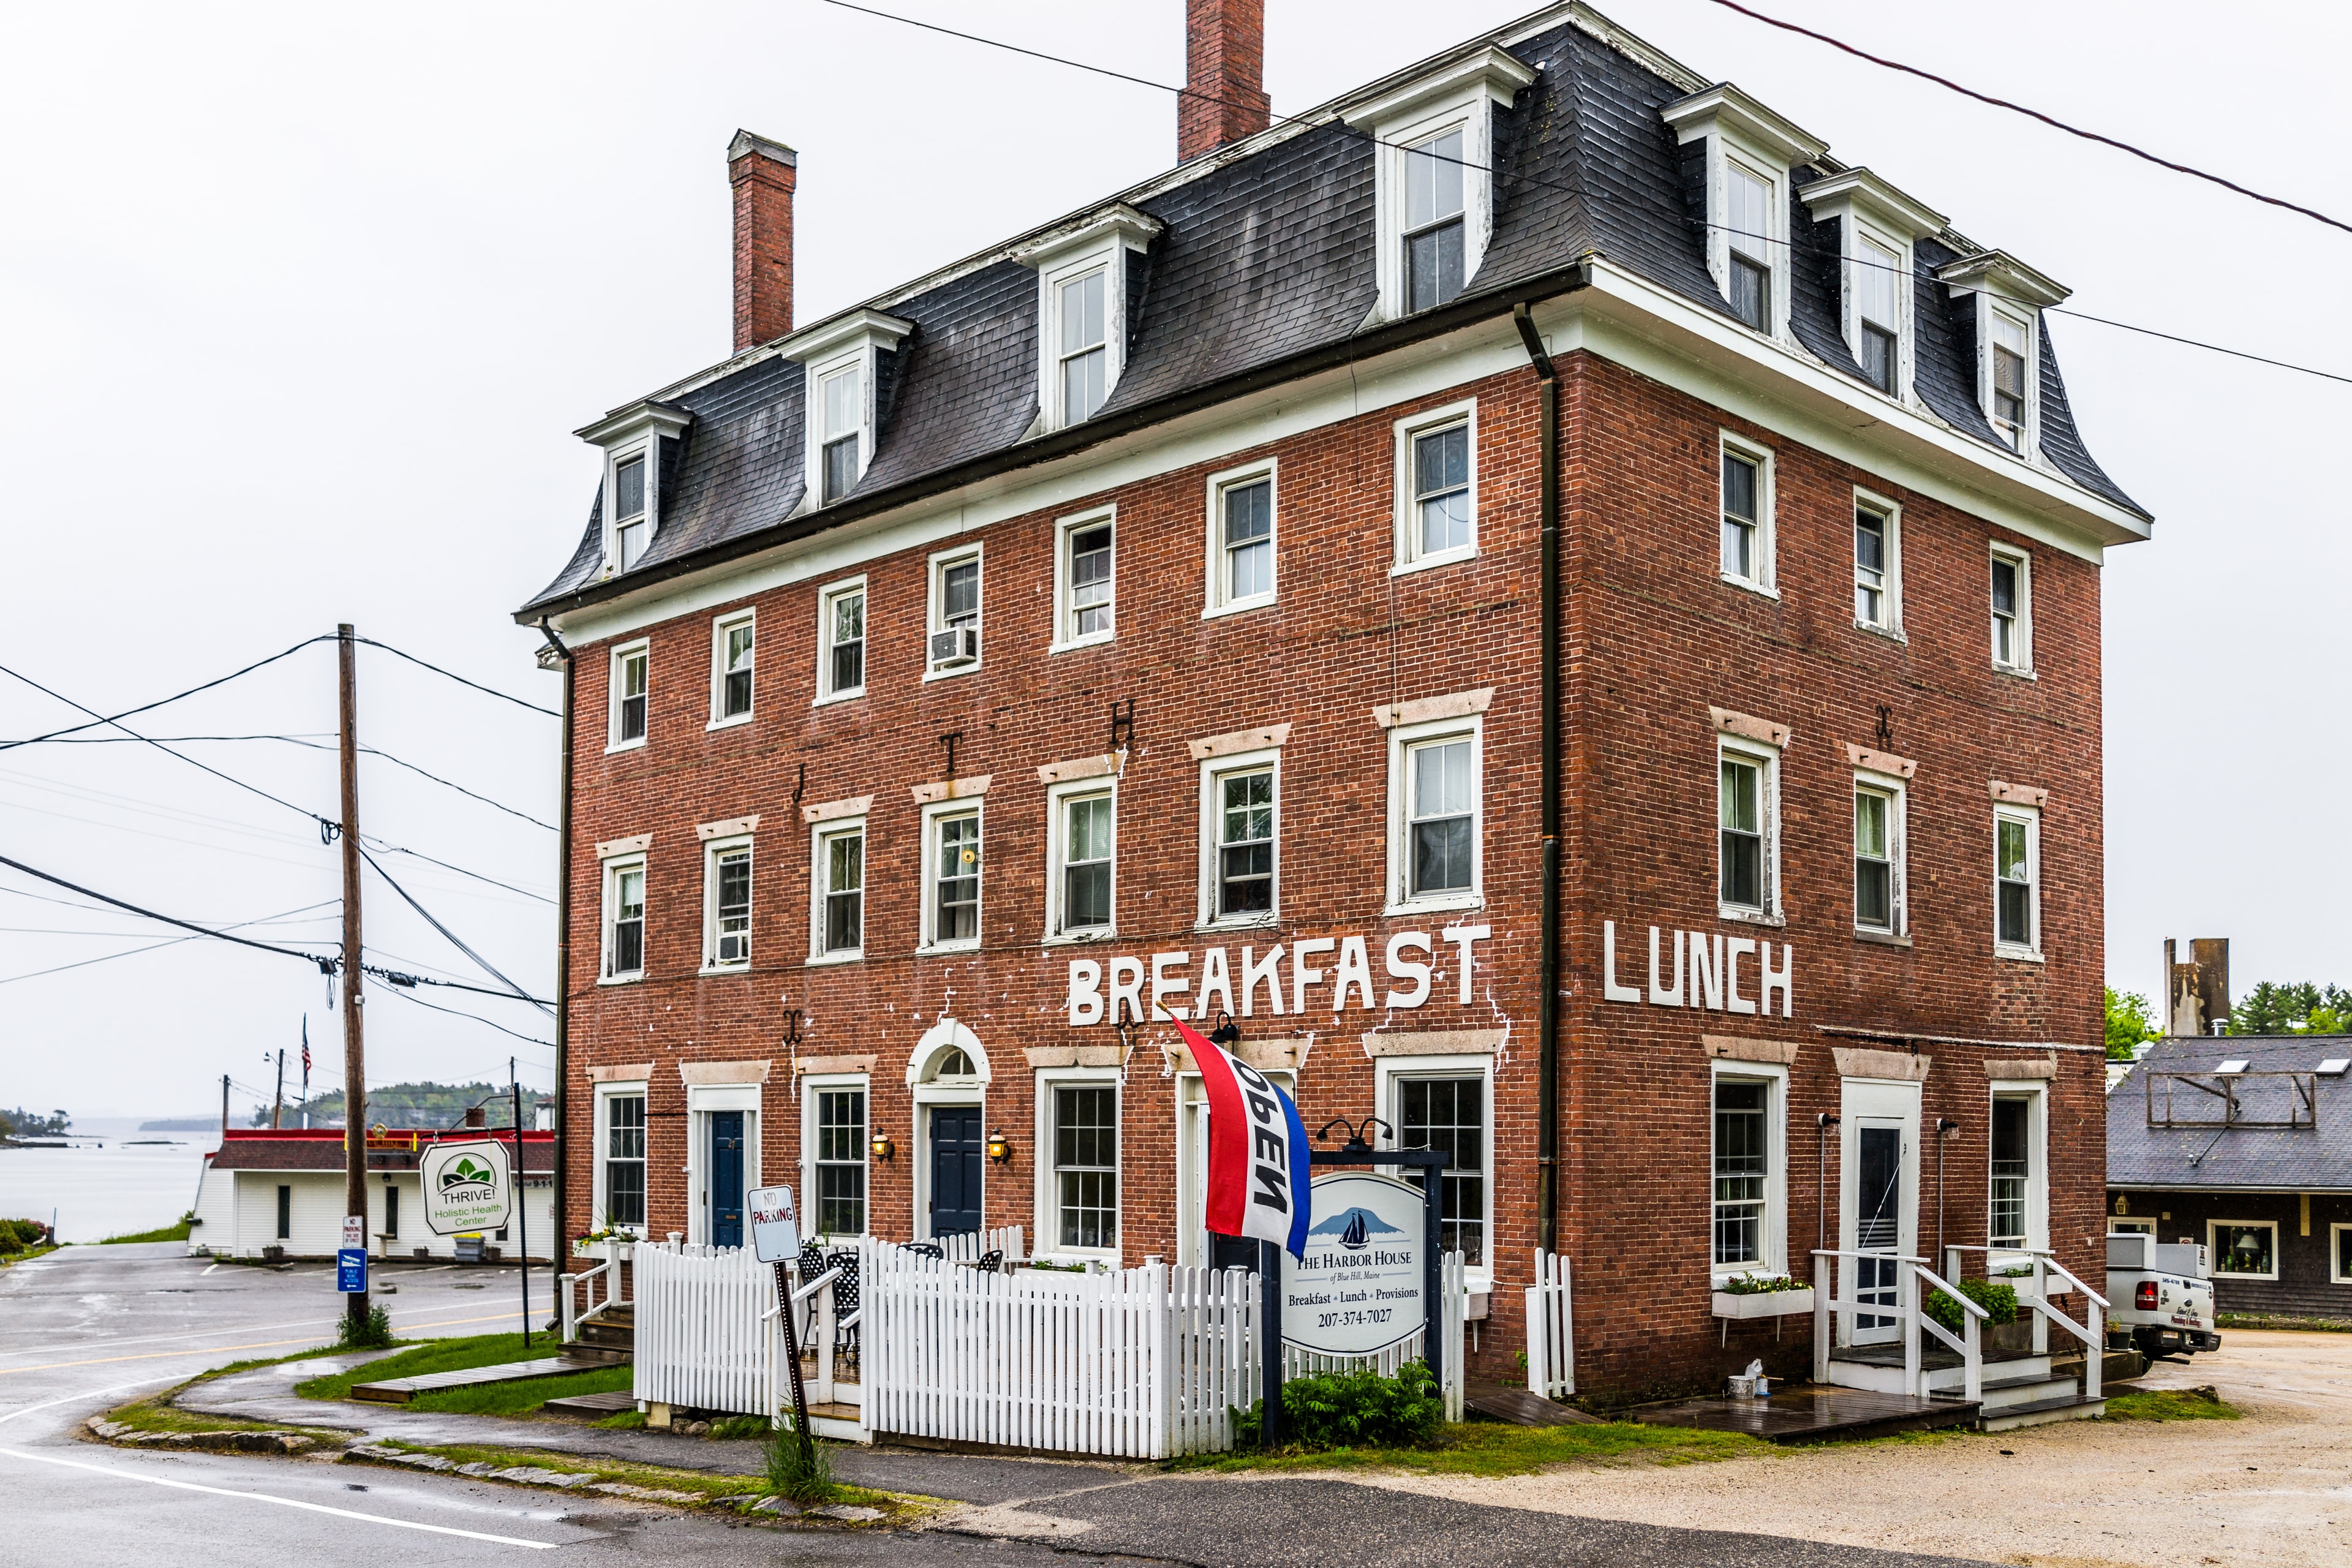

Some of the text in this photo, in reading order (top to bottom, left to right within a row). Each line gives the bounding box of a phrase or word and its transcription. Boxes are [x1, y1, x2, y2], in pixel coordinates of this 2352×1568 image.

[1069, 924, 1491, 1027] BREAKFAST
[1604, 920, 1792, 1018] LUNCH
[442, 1189, 495, 1204] THRIVE!
[763, 1192, 777, 1206] NO
[435, 1204, 502, 1219] Holistic Health
[753, 1207, 793, 1225] PARKING
[455, 1216, 487, 1227] Center
[1323, 1253, 1372, 1268] HARBOR
[1374, 1251, 1412, 1266] HOUSE
[1330, 1270, 1380, 1284] of Blue Hill, Maine
[1289, 1287, 1419, 1306] Breakfast Lunch Provisions
[1318, 1308, 1392, 1328] 207-374-7027
